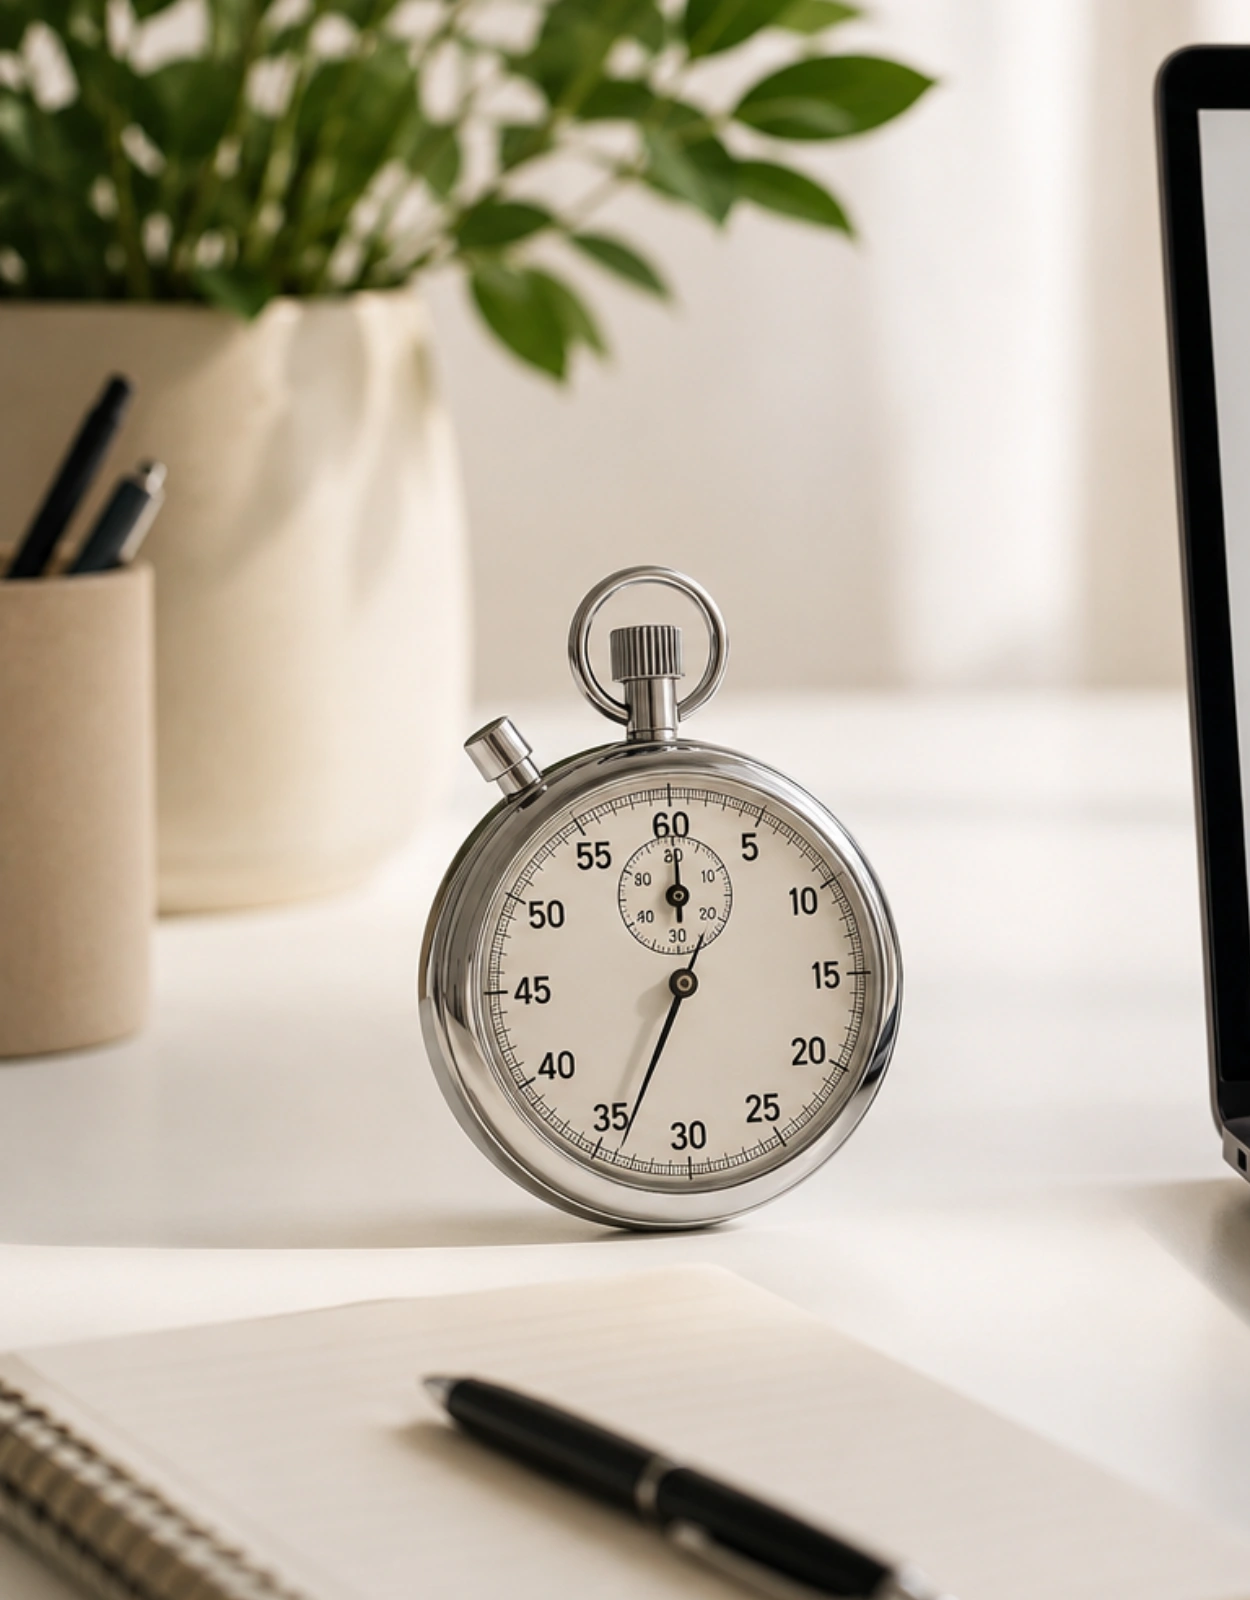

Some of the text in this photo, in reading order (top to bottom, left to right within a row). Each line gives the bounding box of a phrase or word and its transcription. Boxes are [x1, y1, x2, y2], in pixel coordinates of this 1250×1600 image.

[652, 811, 690, 838] 60
[576, 841, 612, 871] 55
[741, 832, 759, 862] 5
[701, 869, 715, 883] 10
[528, 899, 565, 930] 50
[788, 886, 818, 916] 10
[668, 928, 687, 943] 30
[513, 975, 551, 1005] 45
[811, 960, 841, 990] 15
[537, 1050, 575, 1080] 40
[791, 1036, 826, 1066] 20
[594, 1103, 629, 1131] 35
[745, 1092, 781, 1124] 25
[670, 1120, 707, 1151] 30
